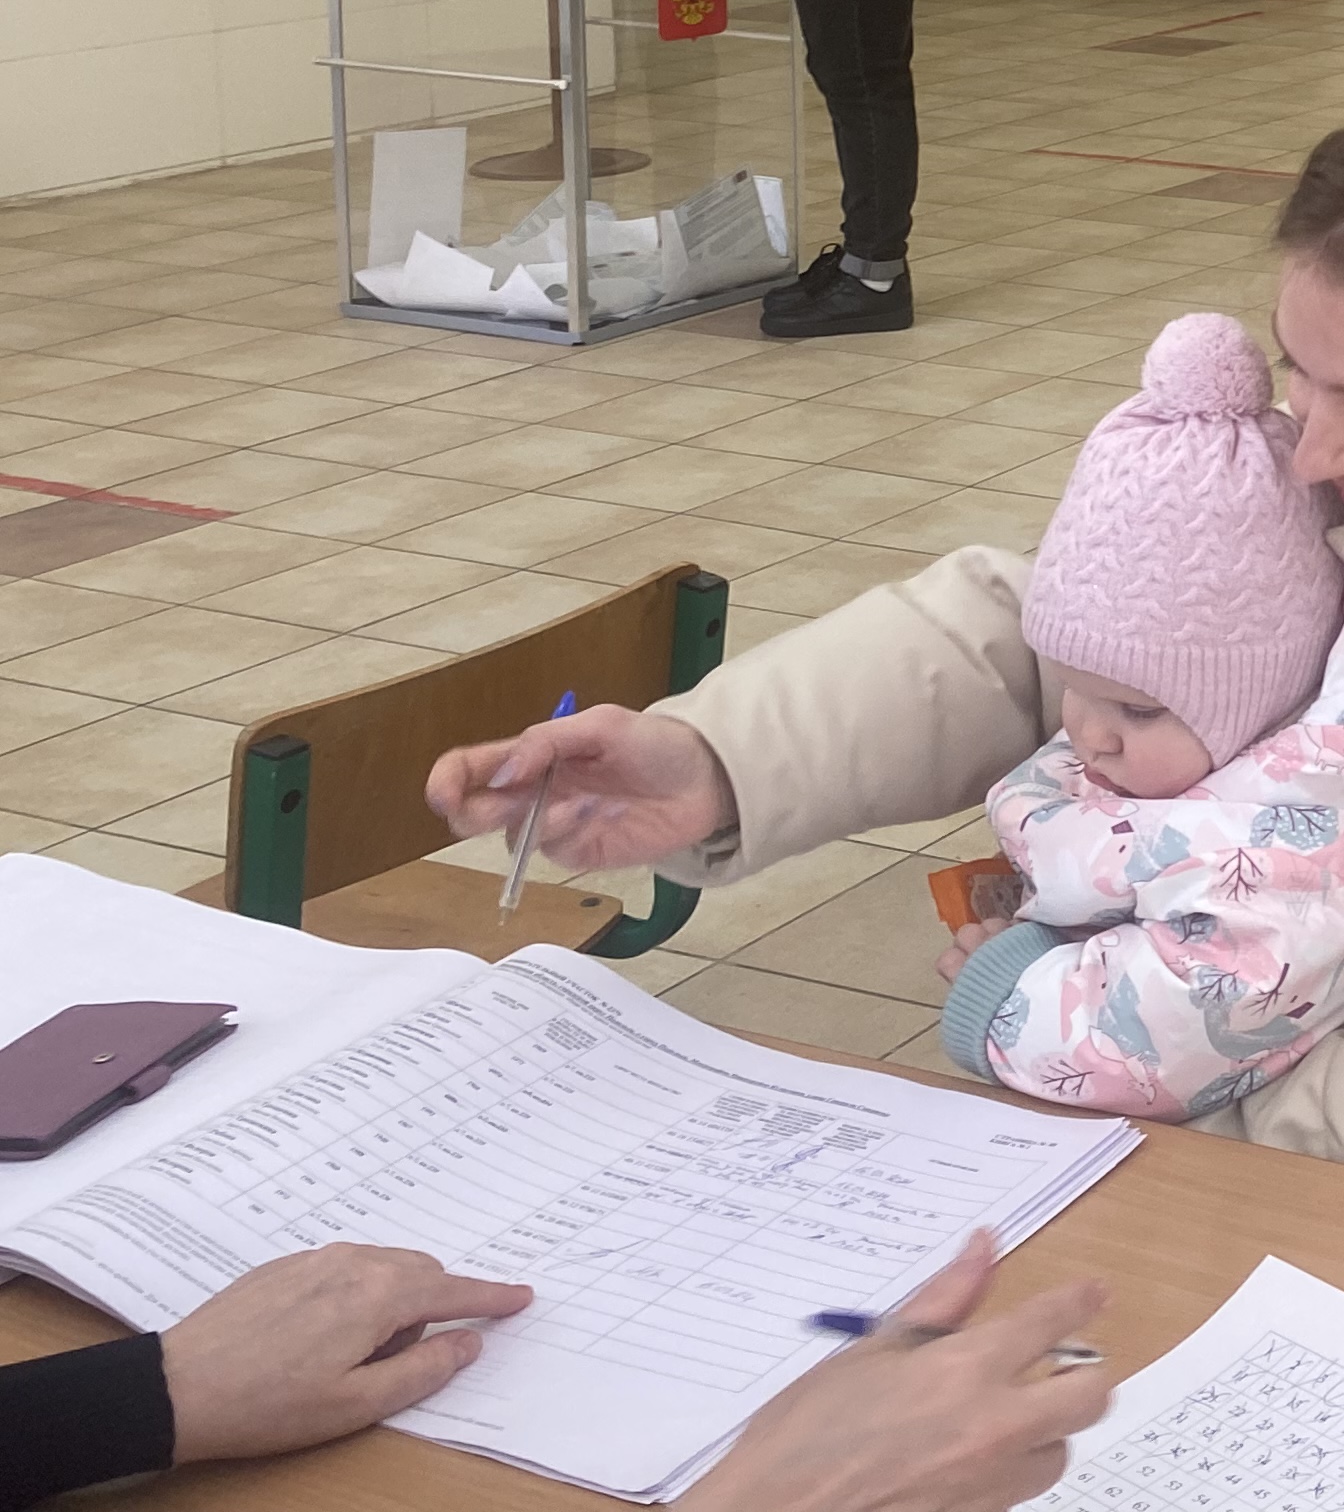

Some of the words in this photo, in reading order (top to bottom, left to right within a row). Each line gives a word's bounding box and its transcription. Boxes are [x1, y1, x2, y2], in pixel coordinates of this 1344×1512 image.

[1077, 1472, 1096, 1484] 61
[1104, 1486, 1124, 1498] 62
[1131, 1500, 1151, 1512] 63
[1109, 1451, 1128, 1463] 51
[1136, 1465, 1156, 1477] 52
[1163, 1480, 1183, 1491] 53
[1191, 1493, 1211, 1506] 54
[1225, 1474, 1243, 1486] 44
[1253, 1488, 1272, 1500] 45
[1043, 1492, 1063, 1505] 71
